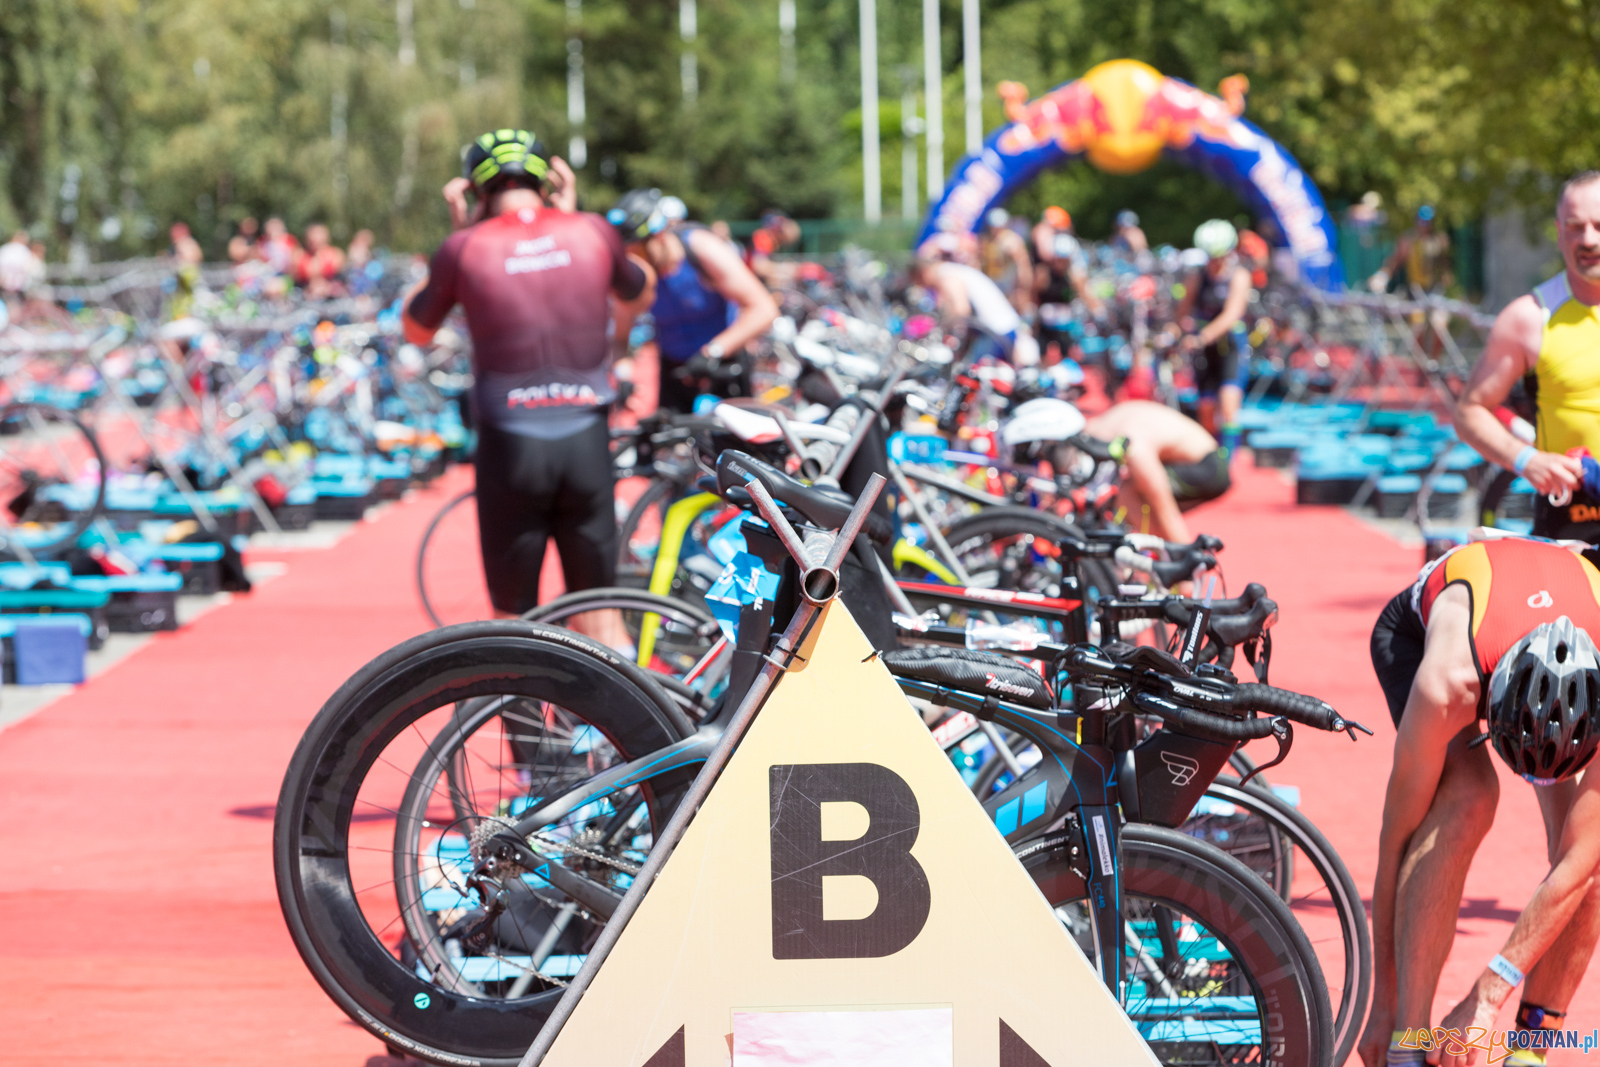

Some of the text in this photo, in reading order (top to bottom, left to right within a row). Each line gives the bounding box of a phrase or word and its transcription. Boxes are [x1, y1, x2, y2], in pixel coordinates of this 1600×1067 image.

[541, 630, 610, 662] CONTINENTAL
[1173, 686, 1195, 698] OVAL
[769, 762, 932, 961] B
